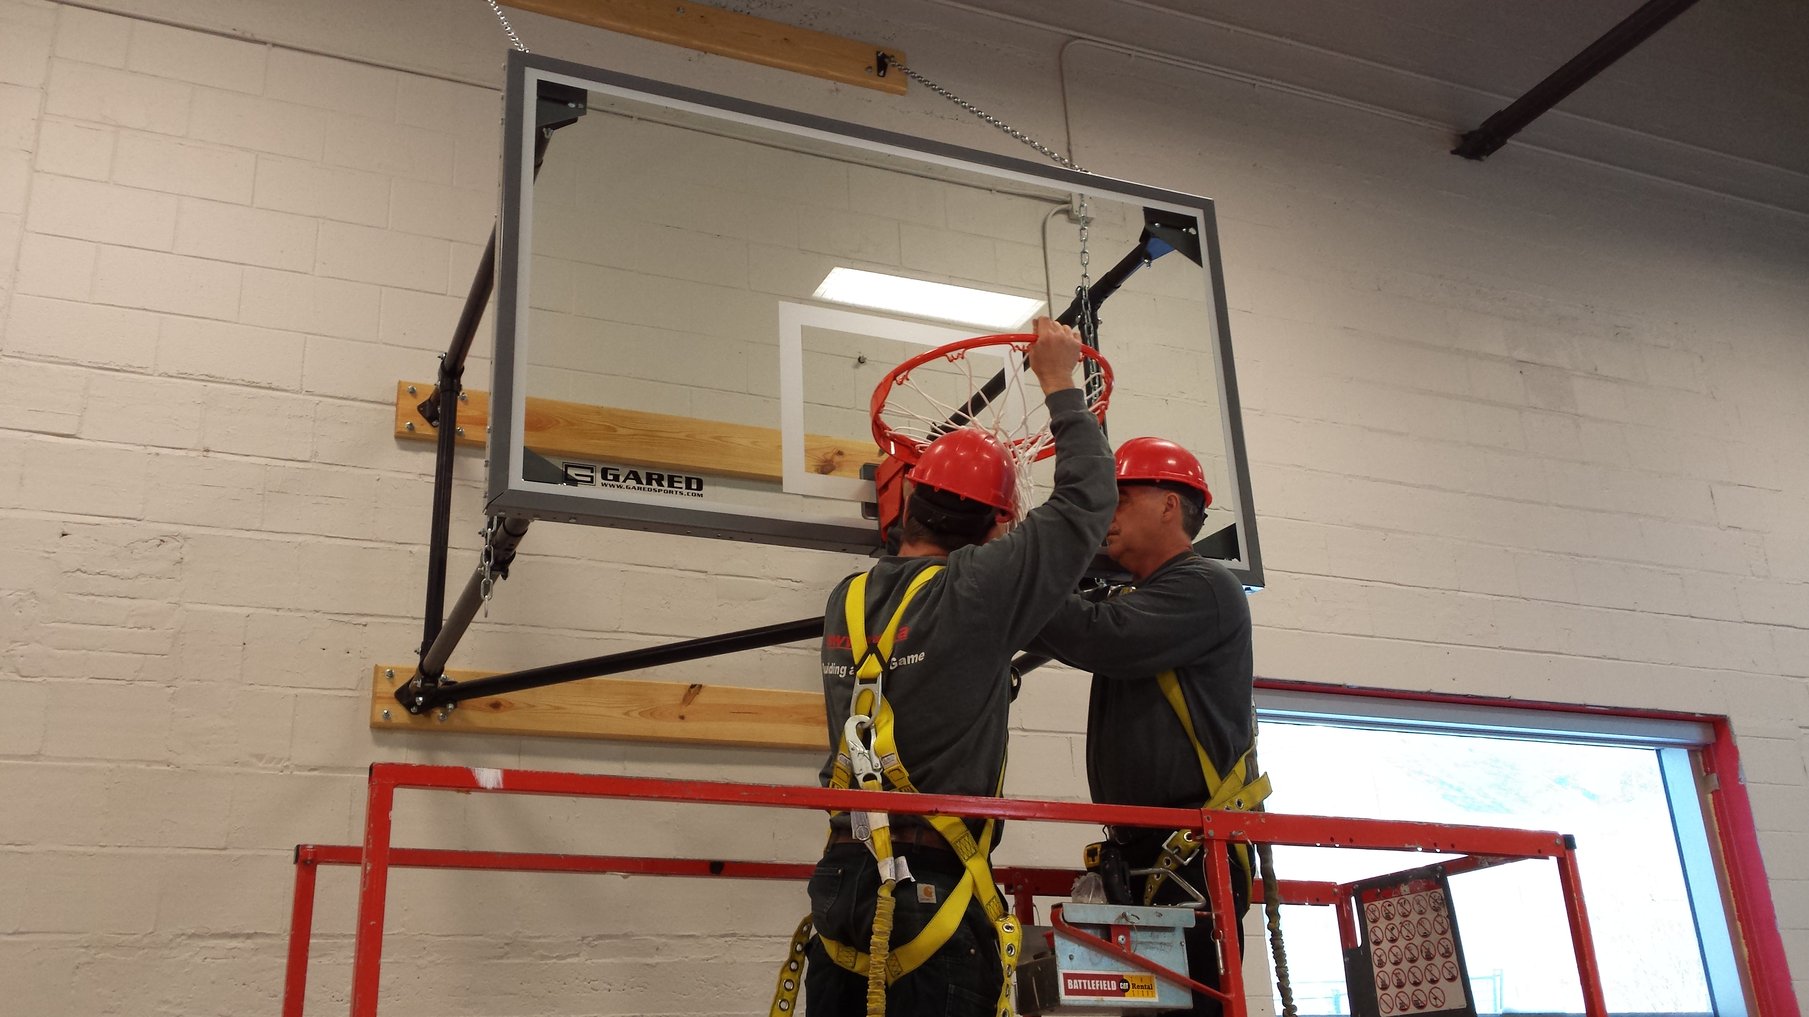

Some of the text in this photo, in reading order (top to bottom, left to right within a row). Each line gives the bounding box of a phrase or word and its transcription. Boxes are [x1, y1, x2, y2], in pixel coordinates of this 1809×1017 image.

[601, 466, 704, 492] GARED
[601, 482, 704, 498] WWW.GAREDSPORTS.COM
[889, 650, 926, 671] Game
[1067, 979, 1117, 991] BATTLEFIELD
[1131, 983, 1153, 991] Rental
